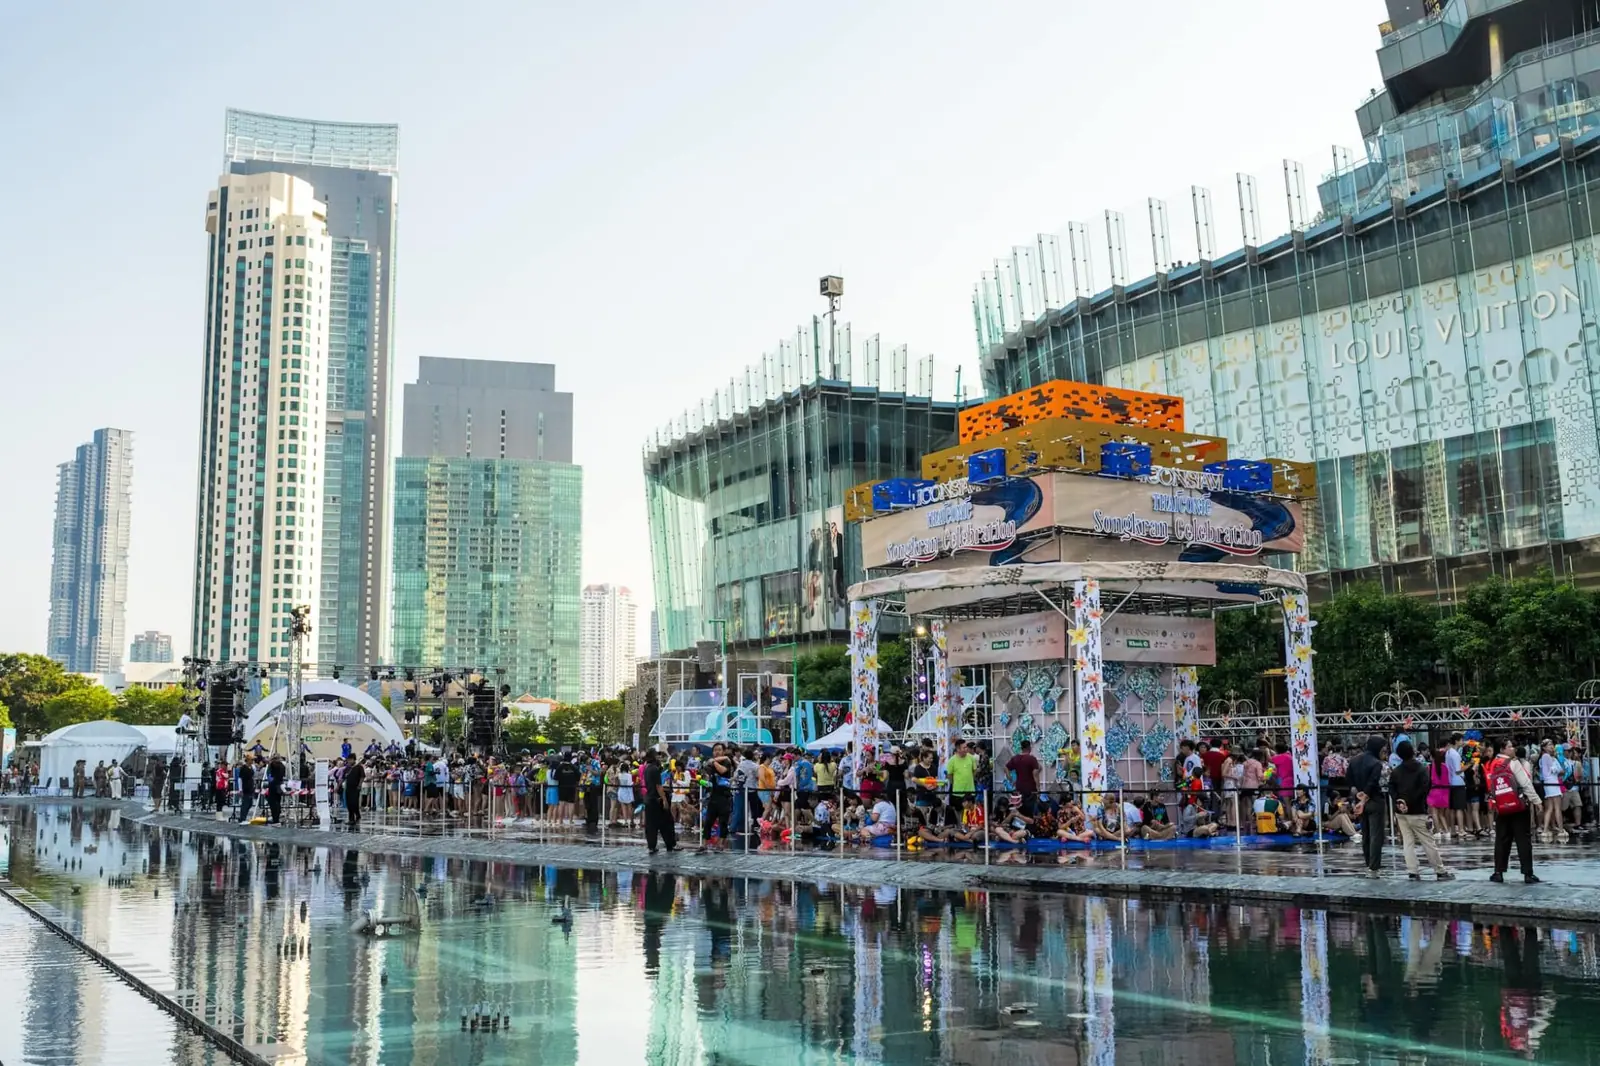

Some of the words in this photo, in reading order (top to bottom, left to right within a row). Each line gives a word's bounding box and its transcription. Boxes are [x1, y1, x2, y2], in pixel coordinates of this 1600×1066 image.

[1331, 324, 1424, 369] LOUIS
[1434, 279, 1588, 345] VUITTON
[941, 519, 1017, 557] Celebration
[1092, 509, 1170, 546] Songkran
[1174, 516, 1263, 556] Celebration
